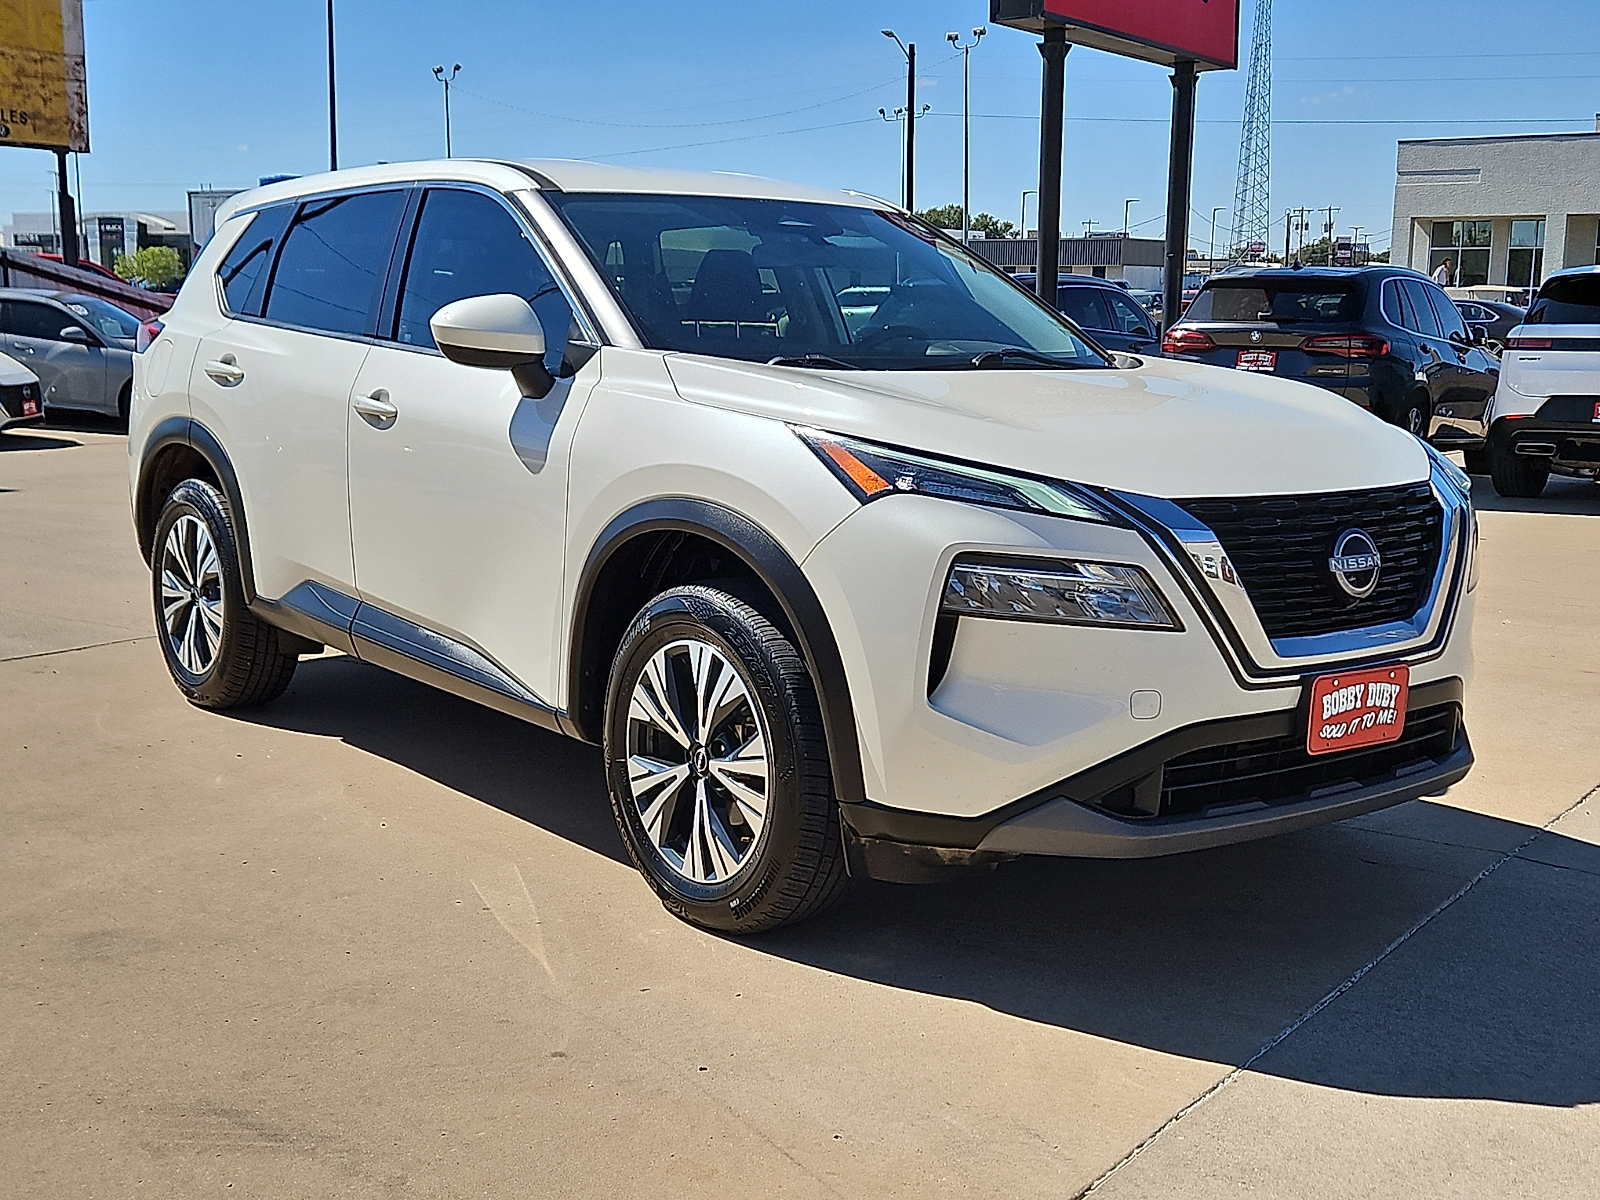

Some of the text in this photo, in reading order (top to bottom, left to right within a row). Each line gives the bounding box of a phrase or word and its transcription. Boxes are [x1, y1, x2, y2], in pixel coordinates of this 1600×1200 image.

[1332, 556, 1380, 570] NISSAN
[1322, 682, 1400, 720] BOBBY DUBY
[1320, 708, 1398, 739] SOLD IT TO ME!
